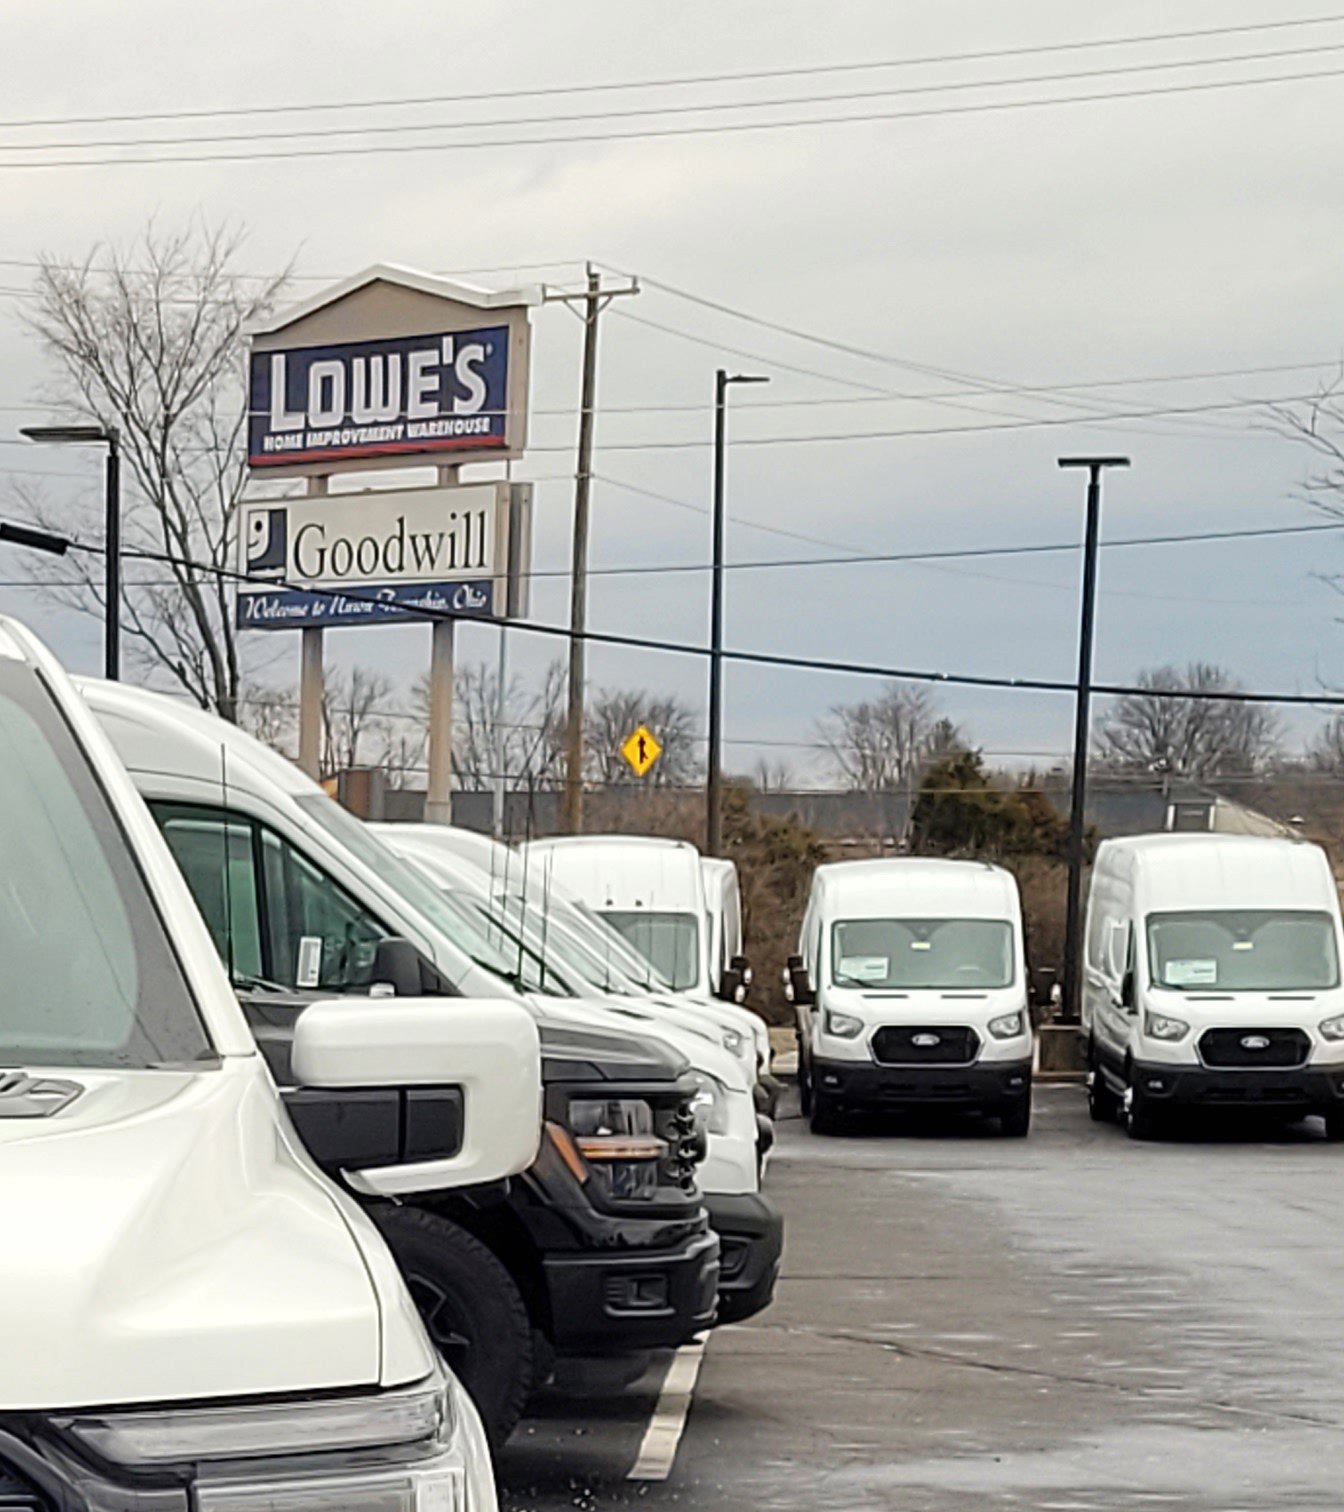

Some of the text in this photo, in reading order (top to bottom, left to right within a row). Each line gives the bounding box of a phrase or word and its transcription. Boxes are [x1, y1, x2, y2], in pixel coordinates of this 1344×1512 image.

[270, 336, 488, 432] LOWE'S
[263, 417, 490, 451] HOME IMPROVEMENT WAREHOUSE
[294, 509, 488, 578] Goodwill
[245, 595, 308, 619] Welcome
[312, 600, 325, 617] to
